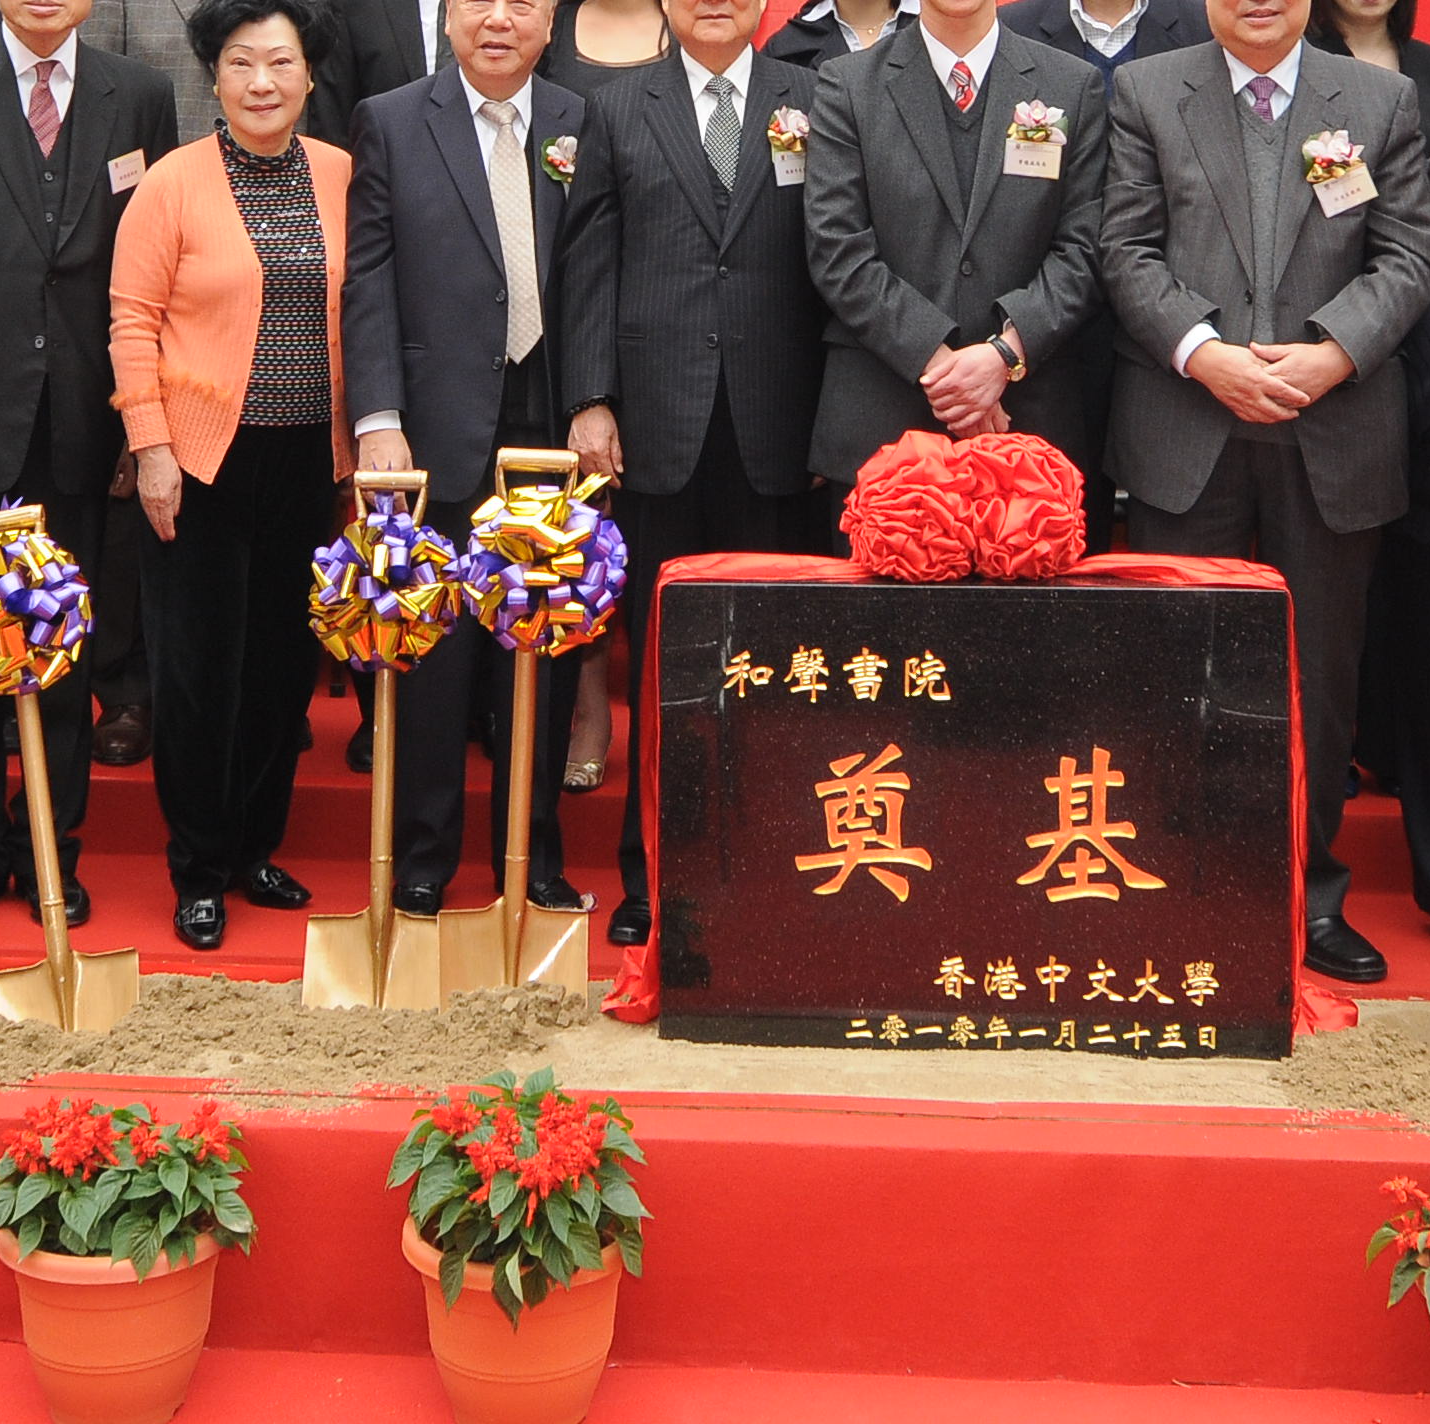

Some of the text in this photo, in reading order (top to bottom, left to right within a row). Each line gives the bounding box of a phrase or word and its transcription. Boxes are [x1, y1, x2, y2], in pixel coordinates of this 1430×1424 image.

[723, 646, 952, 703] 和聲書院
[794, 743, 1168, 904] 奠基
[932, 955, 1220, 1007] 香港中文大學
[844, 1014, 1218, 1049] 二零一零年一月二十五日
